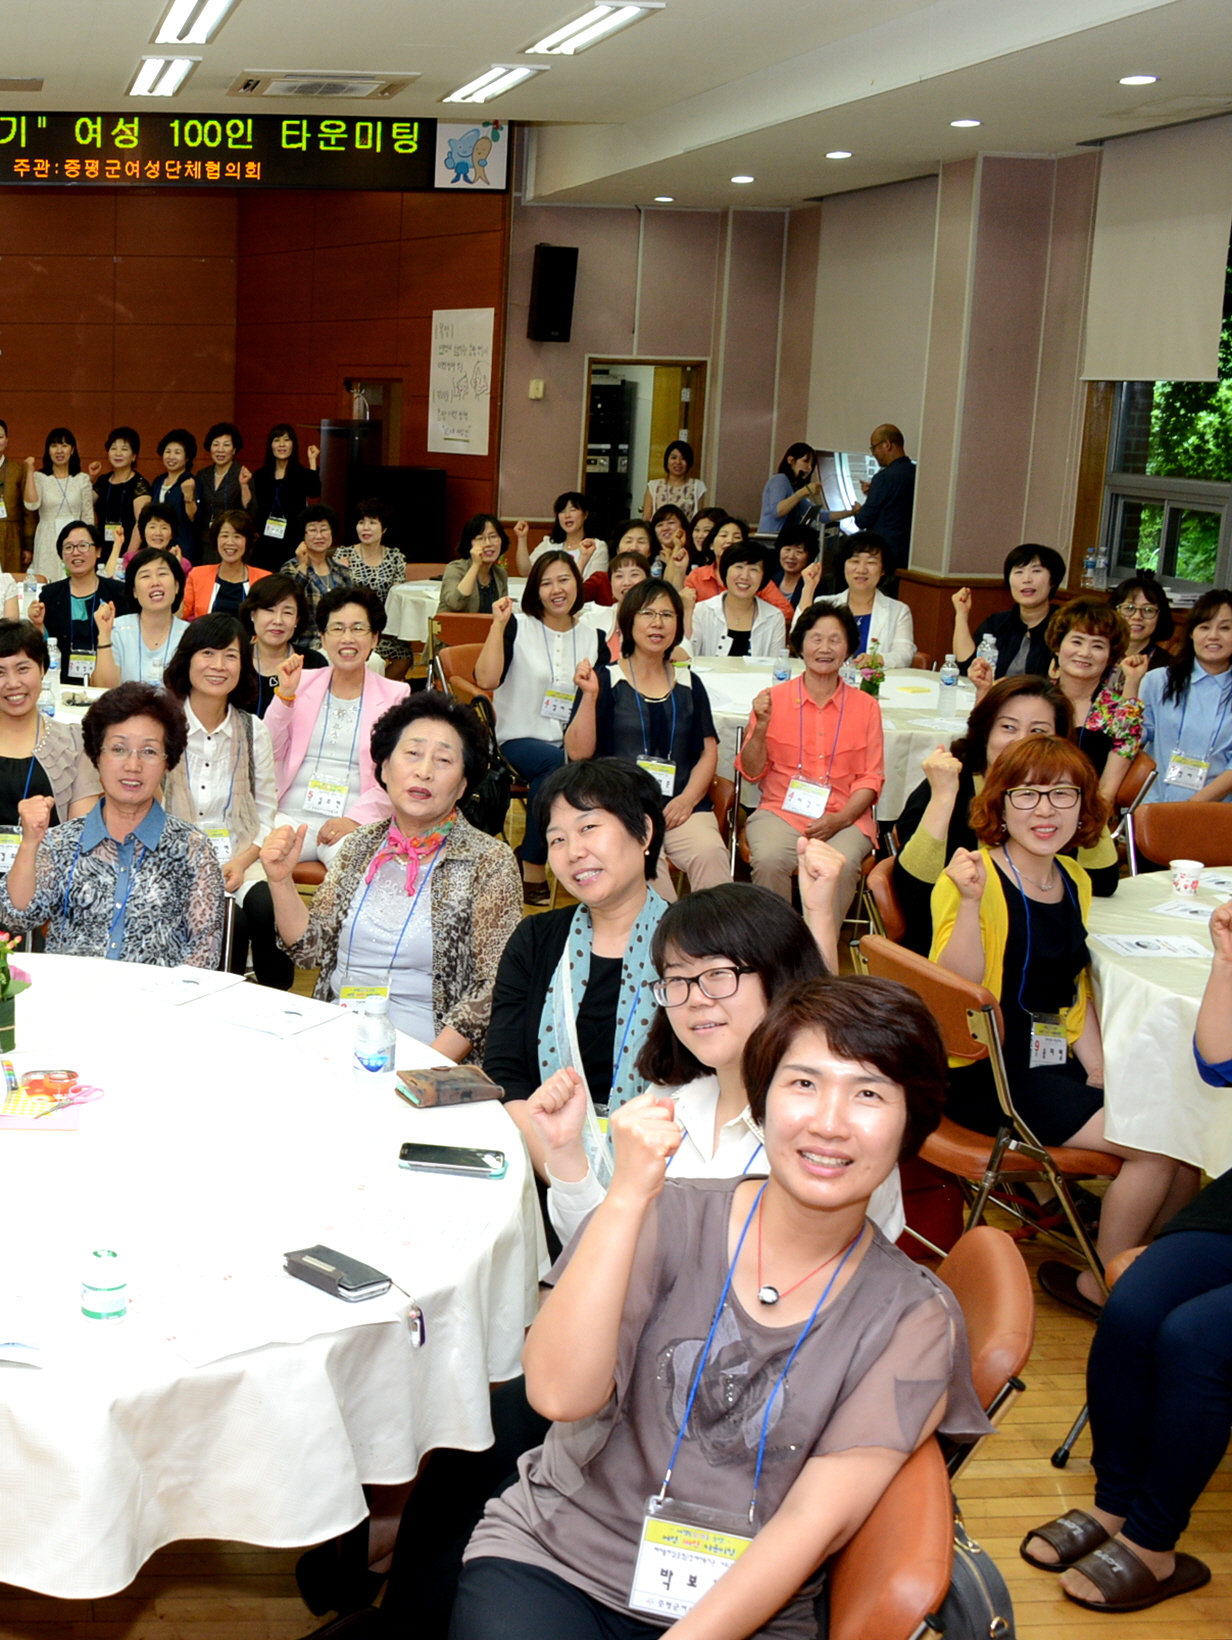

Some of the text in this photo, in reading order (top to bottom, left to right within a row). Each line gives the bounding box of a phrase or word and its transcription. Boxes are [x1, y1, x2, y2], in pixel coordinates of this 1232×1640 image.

[74, 116, 140, 149] 여성
[169, 118, 254, 150] 100인
[281, 119, 420, 154] 타운미팅
[1034, 1040, 1040, 1052] 9
